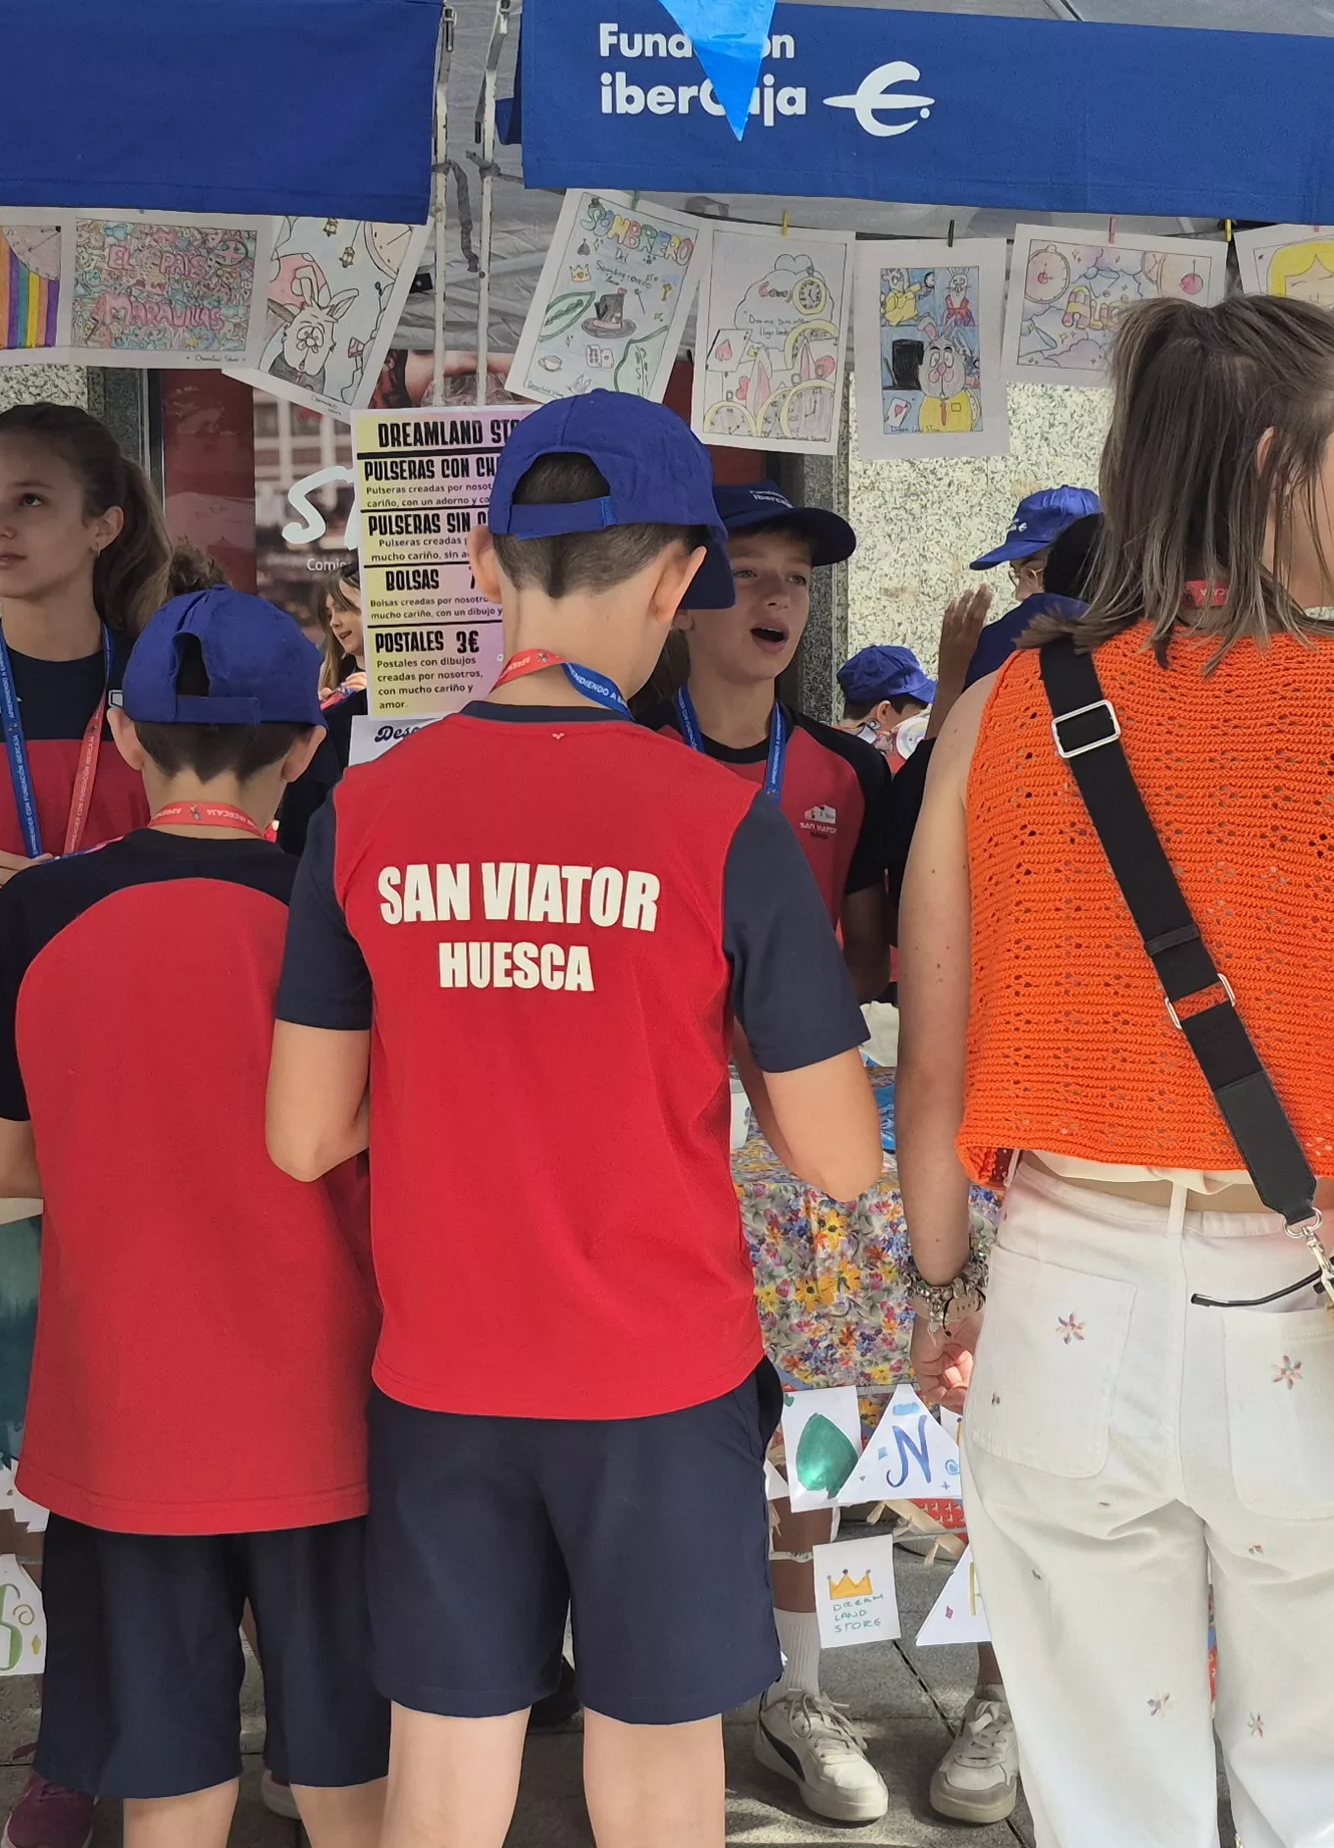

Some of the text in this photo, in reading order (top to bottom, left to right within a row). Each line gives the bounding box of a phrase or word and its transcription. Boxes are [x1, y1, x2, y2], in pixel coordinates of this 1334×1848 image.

[377, 420, 483, 448] DREAMLAND
[364, 459, 436, 481] PULSERAS
[441, 456, 470, 479] CON
[366, 486, 406, 494] Pulseras
[408, 484, 445, 493] creadas
[447, 484, 463, 495] por
[366, 498, 400, 509] cariño,
[421, 498, 434, 506] un
[436, 496, 469, 506] adorno
[471, 497, 477, 507] y
[368, 511, 471, 536] PULSERAS SIN
[378, 537, 462, 547] Pulseras creadas
[371, 553, 406, 562] mucho
[407, 550, 442, 561] cariño,
[444, 550, 459, 559] sin
[385, 569, 440, 592] BOLSAS
[370, 599, 399, 608] Bolsas
[400, 597, 435, 606] creadas
[437, 597, 452, 606] por
[371, 611, 402, 620] mucho
[403, 610, 434, 619] cariño,
[468, 607, 495, 617] dibujo
[497, 607, 503, 617] y
[375, 630, 480, 654] POSTALES 3€
[377, 656, 477, 669] Postales con dibujos
[377, 670, 484, 683] creadas por nosotros,
[378, 683, 474, 696] con mucho cariño y
[377, 861, 661, 932] SAN VIATOR
[438, 941, 595, 992] HUESCA
[886, 1414, 932, 1488] N
[832, 1593, 884, 1612] DREAM
[834, 1609, 868, 1622] LAND
